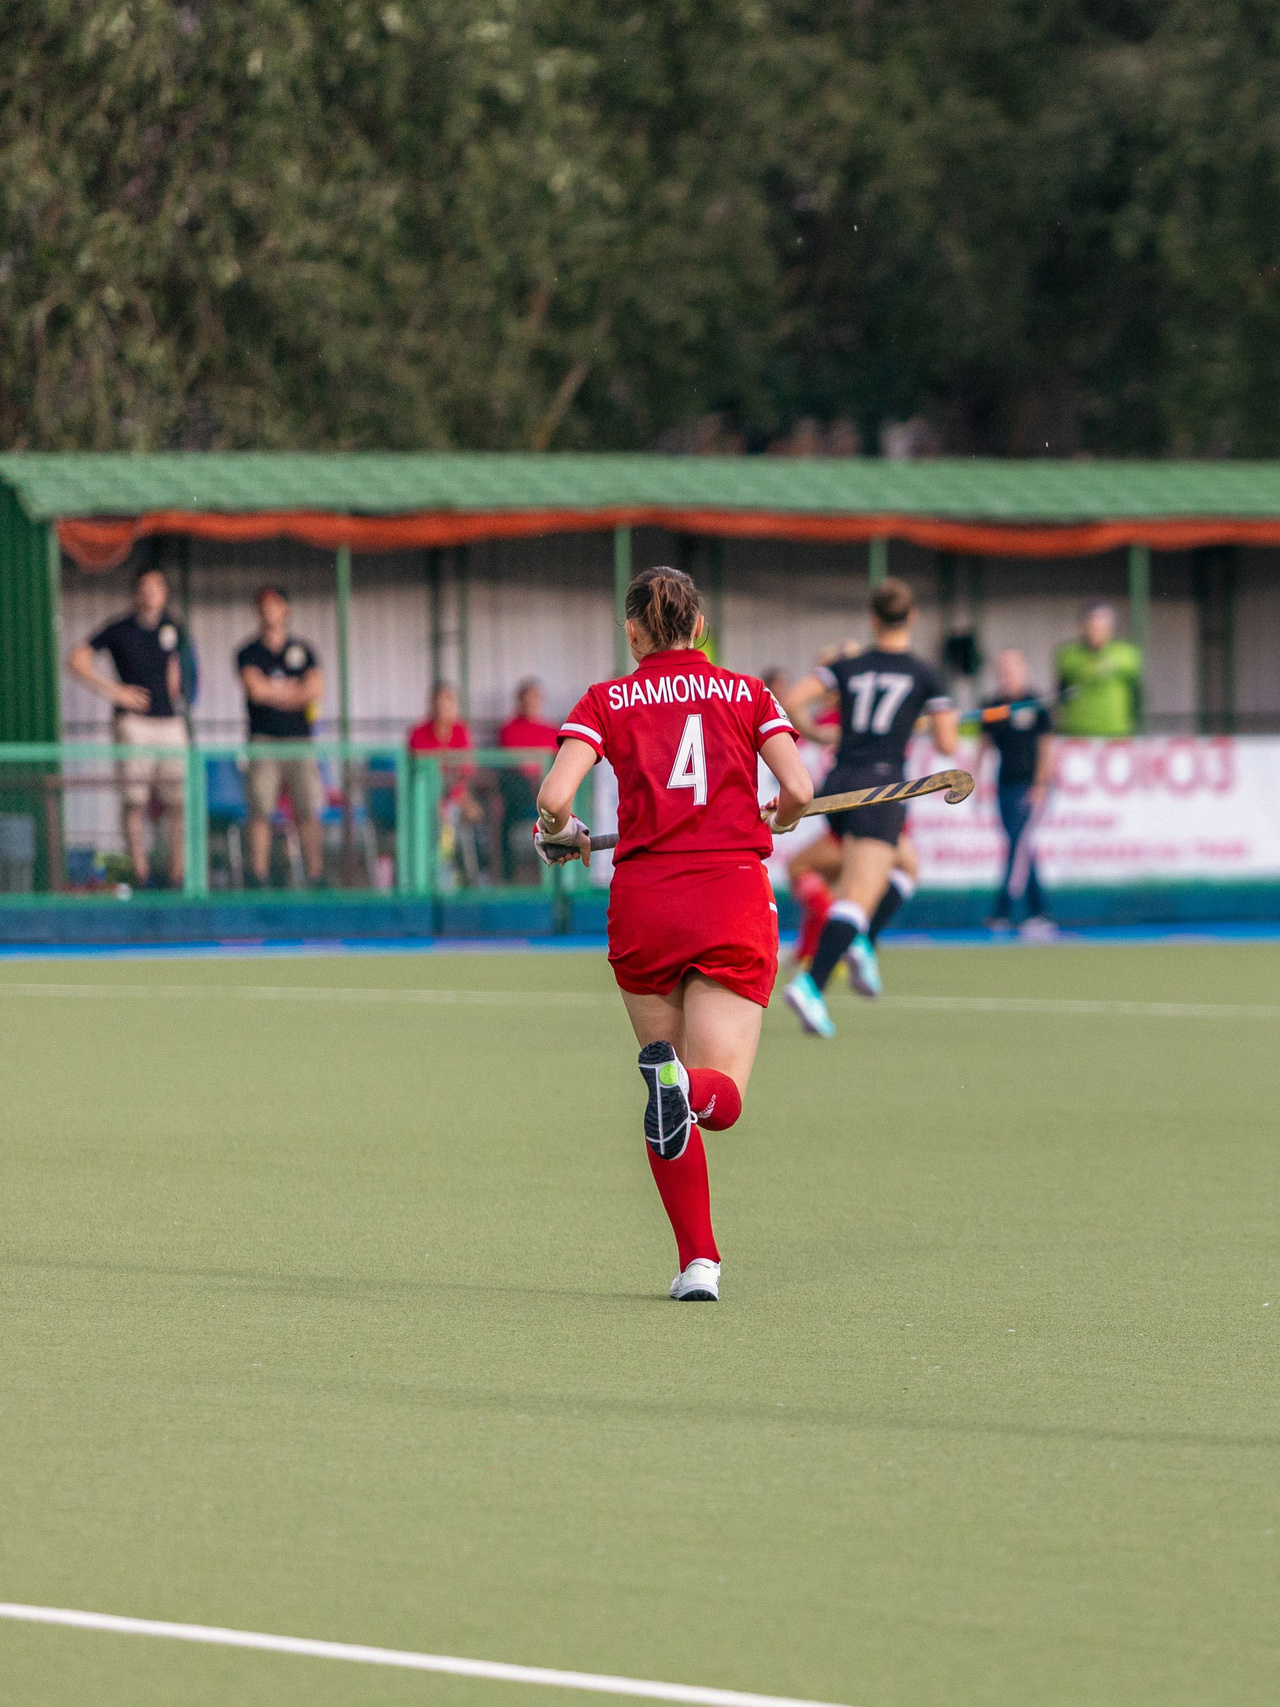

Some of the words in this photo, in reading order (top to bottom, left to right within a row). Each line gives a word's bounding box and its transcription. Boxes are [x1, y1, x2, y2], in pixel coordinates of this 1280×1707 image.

[608, 674, 753, 711] SIAMIONAVA
[847, 672, 914, 734] 17
[666, 713, 709, 806] 4
